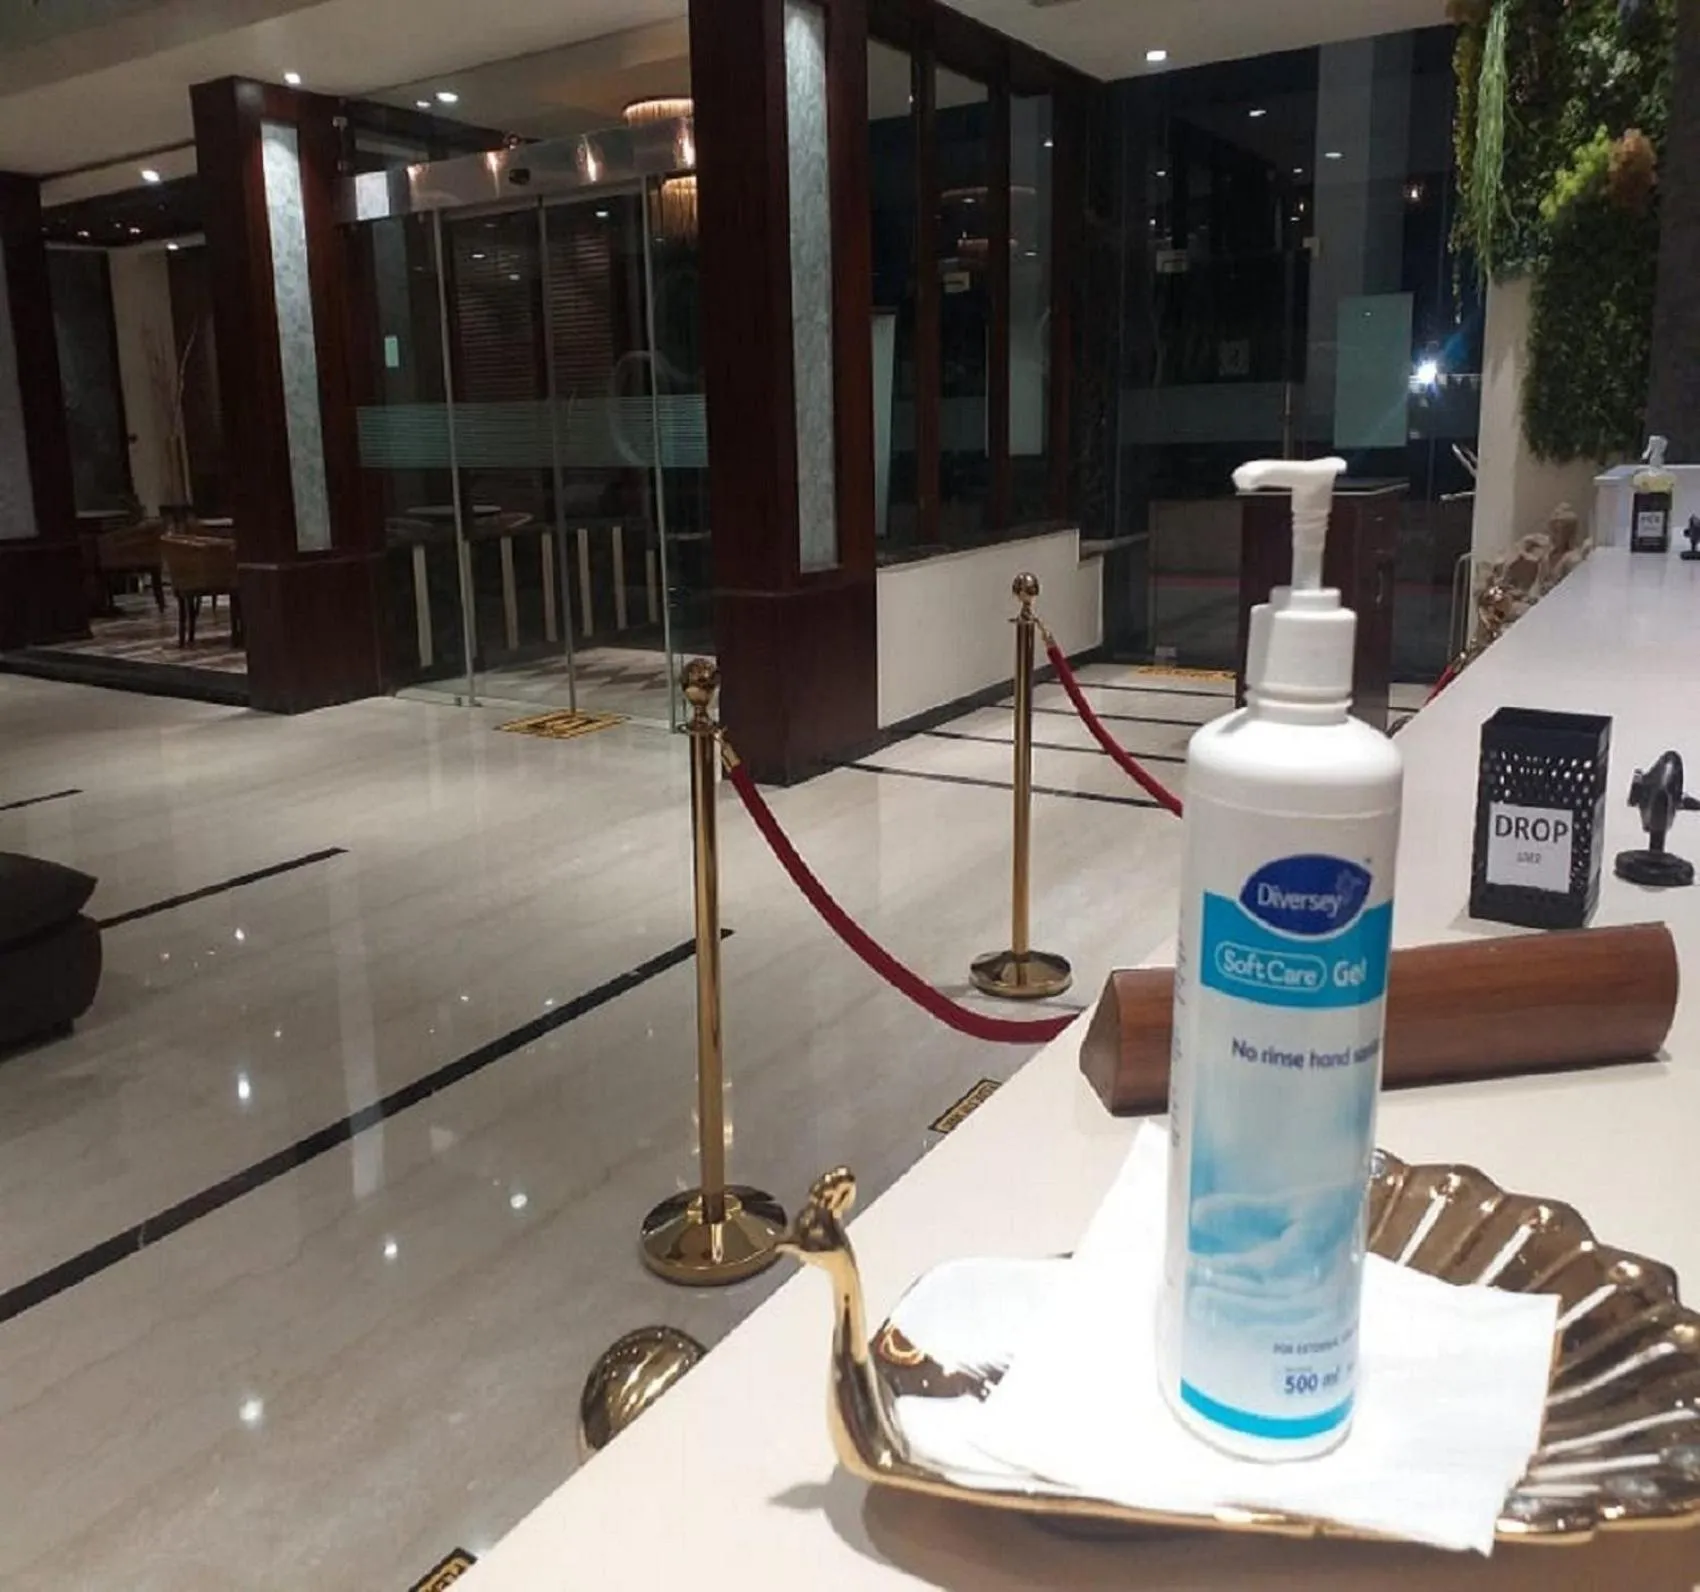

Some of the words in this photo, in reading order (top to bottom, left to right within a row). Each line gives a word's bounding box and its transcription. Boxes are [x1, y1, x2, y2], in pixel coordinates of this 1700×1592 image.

[1495, 814, 1569, 843] DROP
[1257, 882, 1342, 918] Diversey
[1333, 956, 1367, 987] Gel
[1232, 1037, 1258, 1062] No
[1262, 1045, 1305, 1069] rinse
[1309, 1045, 1350, 1068] hand
[1284, 1373, 1318, 1394] 500
